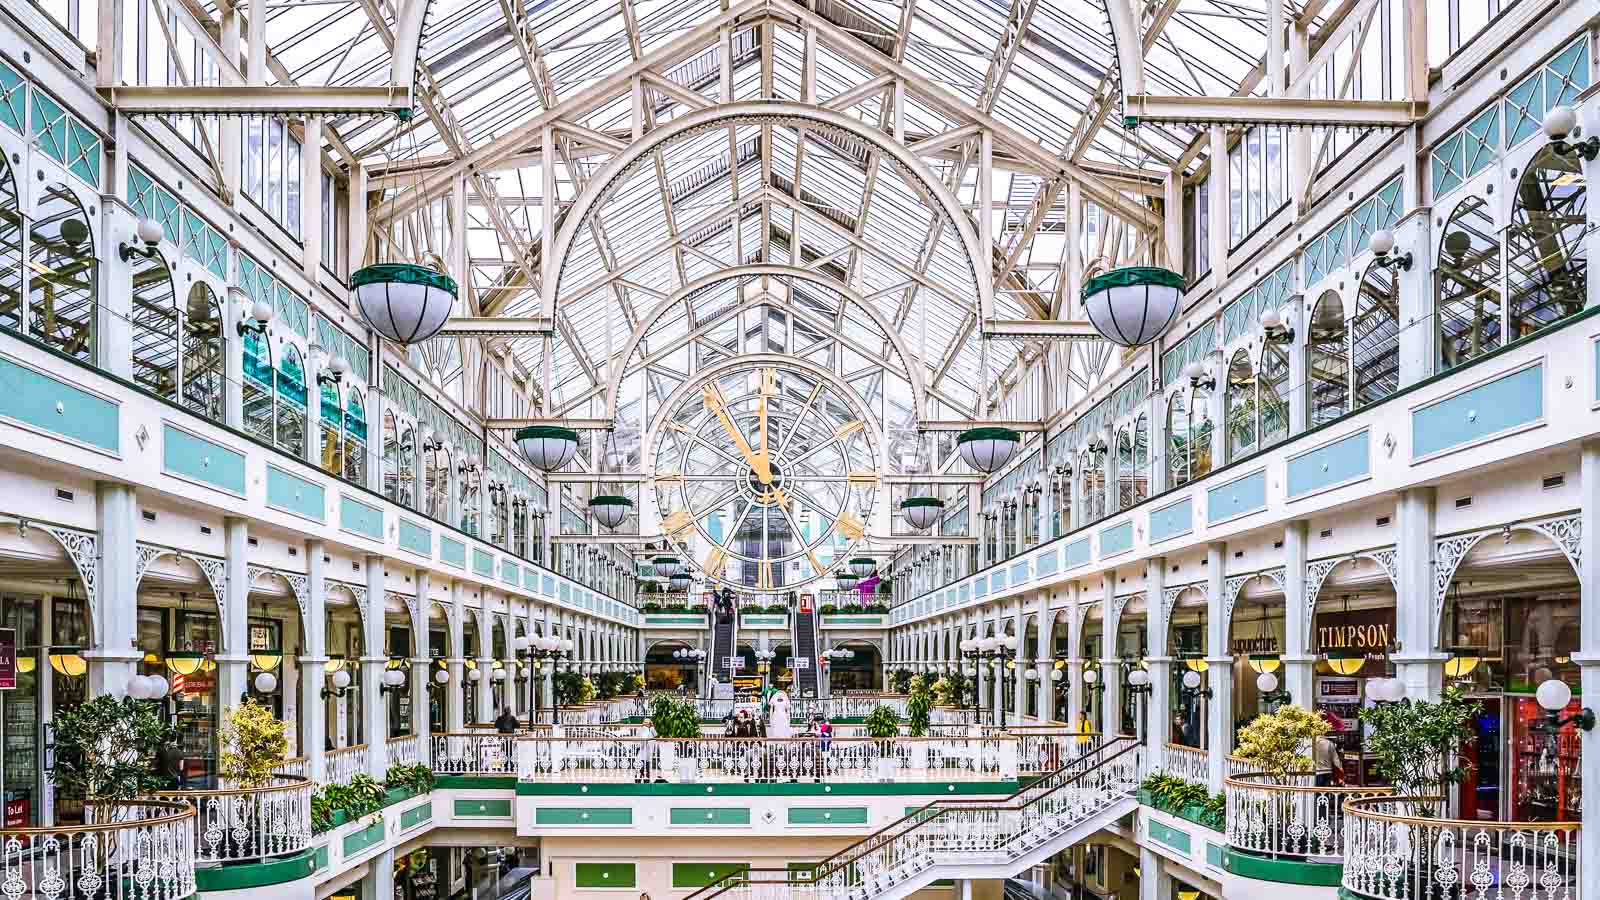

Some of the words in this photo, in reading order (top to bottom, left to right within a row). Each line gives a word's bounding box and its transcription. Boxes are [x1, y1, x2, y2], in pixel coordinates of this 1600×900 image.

[1319, 623, 1388, 647] TIMPSON
[7, 806, 14, 816] To
[15, 804, 23, 814] Let
